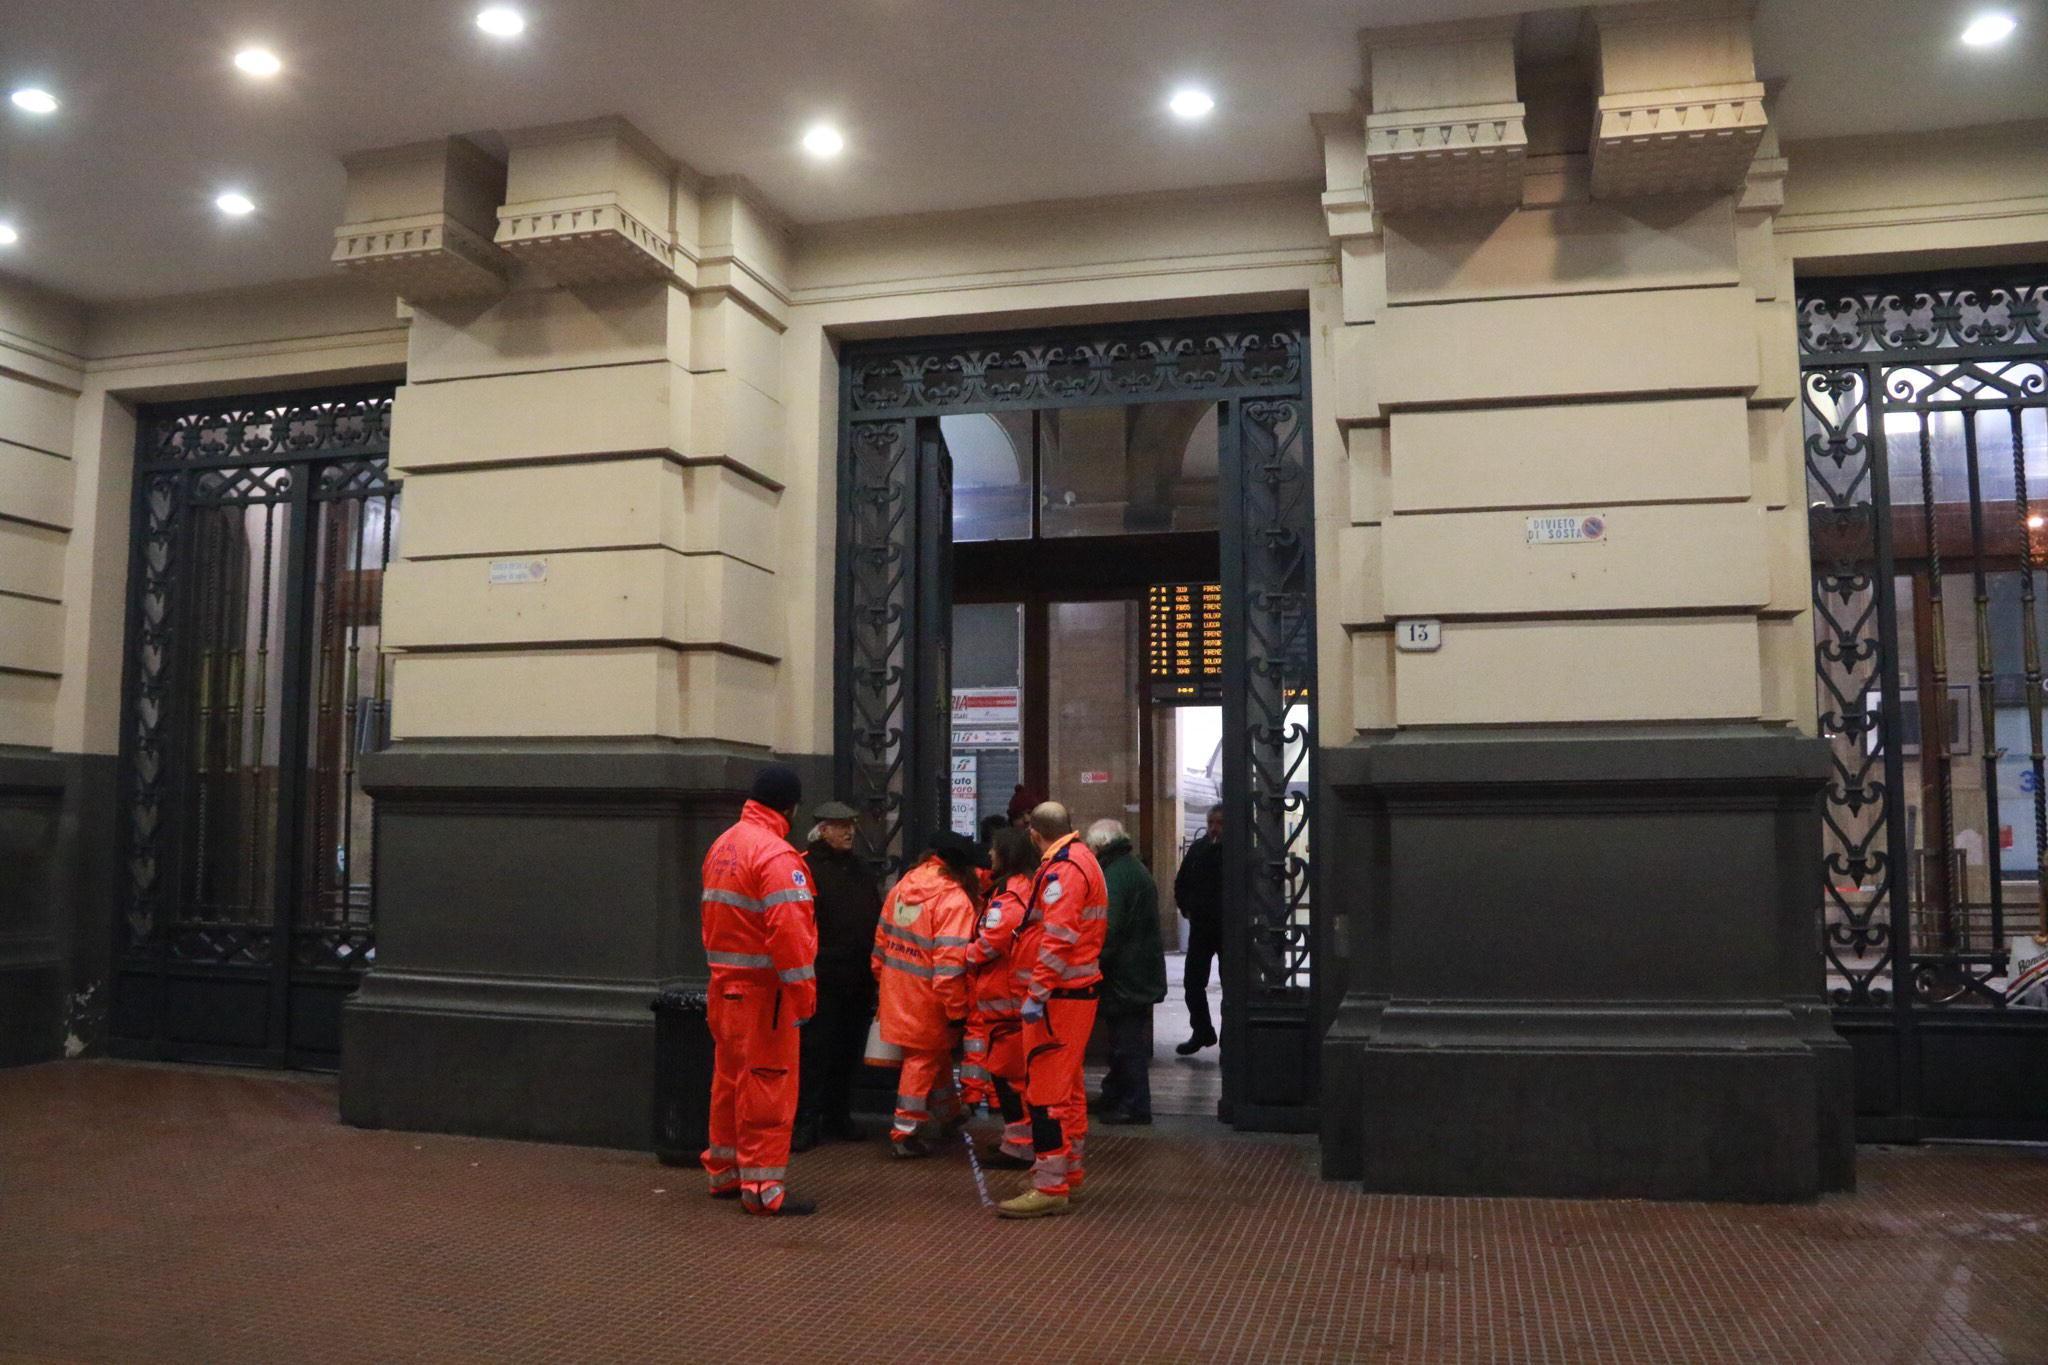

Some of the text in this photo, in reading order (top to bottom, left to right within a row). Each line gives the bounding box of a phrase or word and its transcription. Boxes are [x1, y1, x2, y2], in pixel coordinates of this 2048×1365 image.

[1533, 518, 1575, 530] DIVIETO
[1527, 528, 1582, 540] DI SOSTA
[1409, 623, 1428, 641] 13
[1203, 648, 1222, 656] FIRENZ
